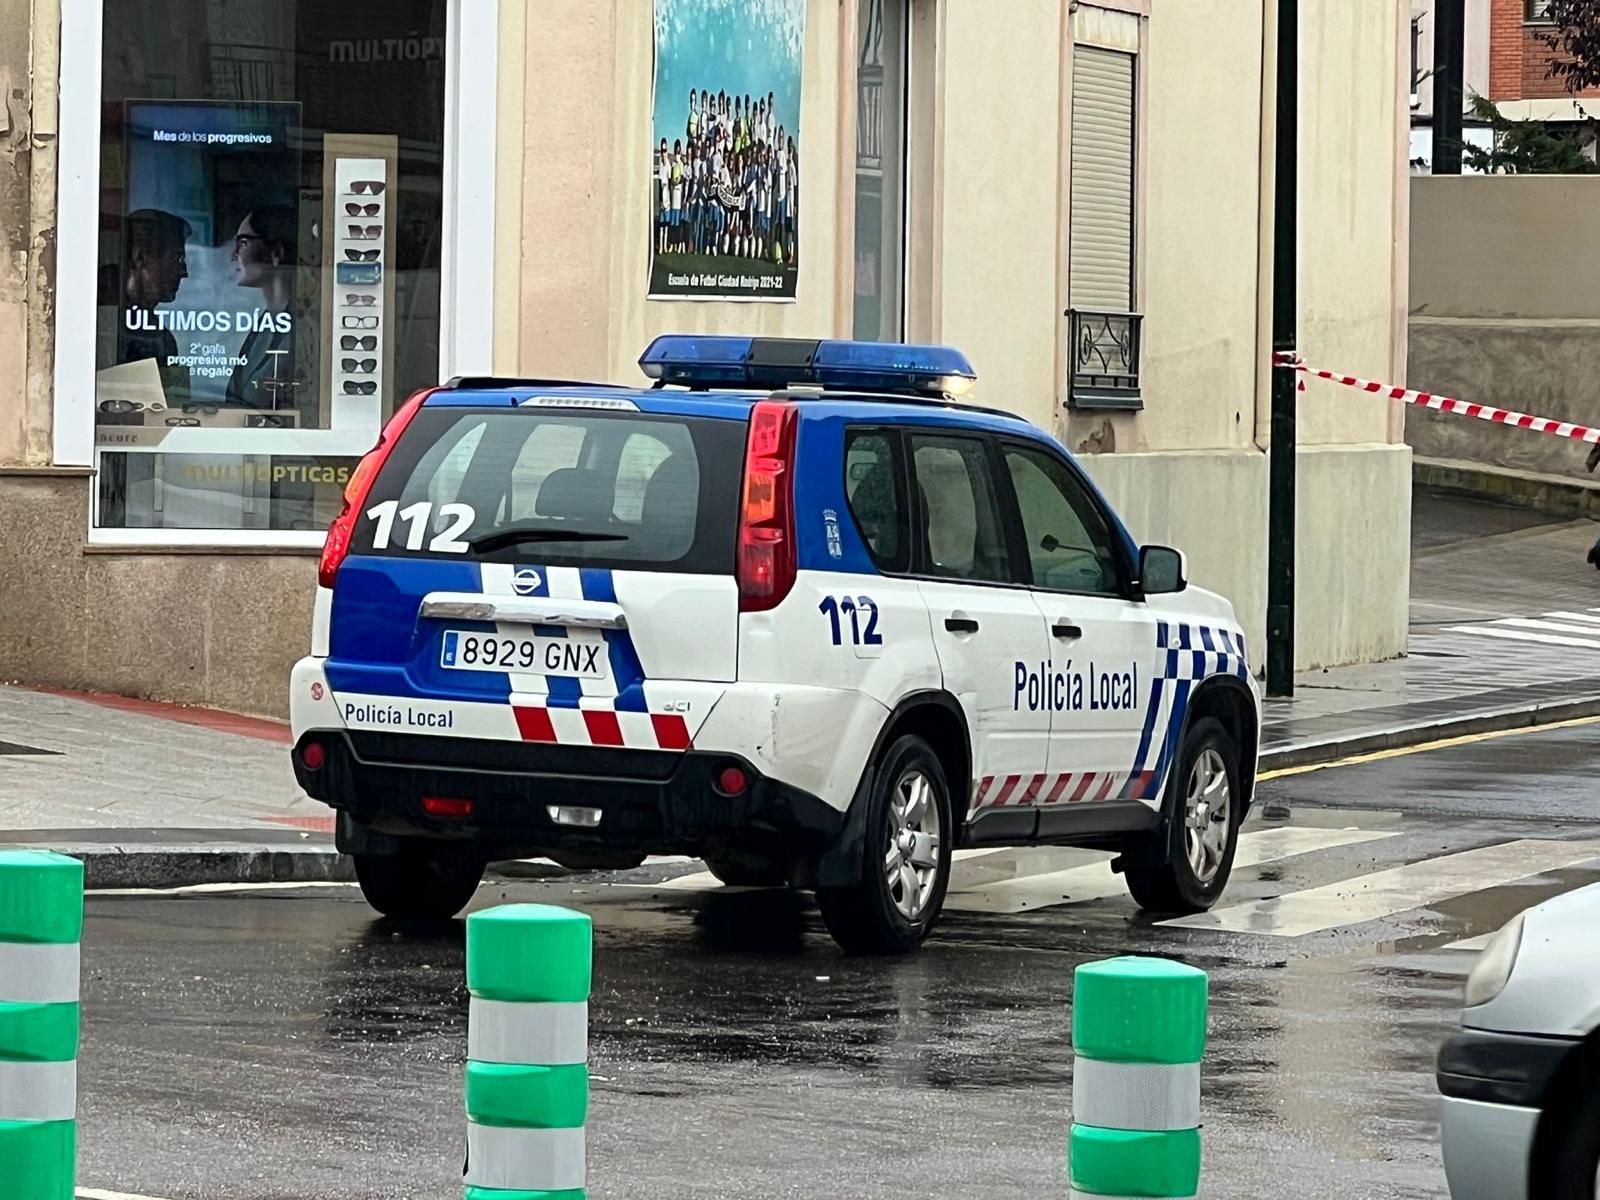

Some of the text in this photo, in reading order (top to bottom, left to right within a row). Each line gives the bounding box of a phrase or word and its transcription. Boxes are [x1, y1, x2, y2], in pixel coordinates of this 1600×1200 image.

[153, 130, 272, 144] Mes de los progresivos
[668, 273, 689, 286] Escuela
[690, 274, 699, 287] de
[718, 275, 740, 288] Ciudad
[760, 276, 783, 289] 2021-22
[125, 305, 292, 333] ÚLTIMOS DÍAS
[167, 353, 228, 367] progresiva
[197, 365, 234, 378] regalo
[366, 500, 475, 553] 112
[818, 595, 883, 646] 112
[445, 637, 600, 673] E 8929 GNX
[1014, 659, 1138, 711] Policía Local
[345, 703, 453, 728] Policía Local
